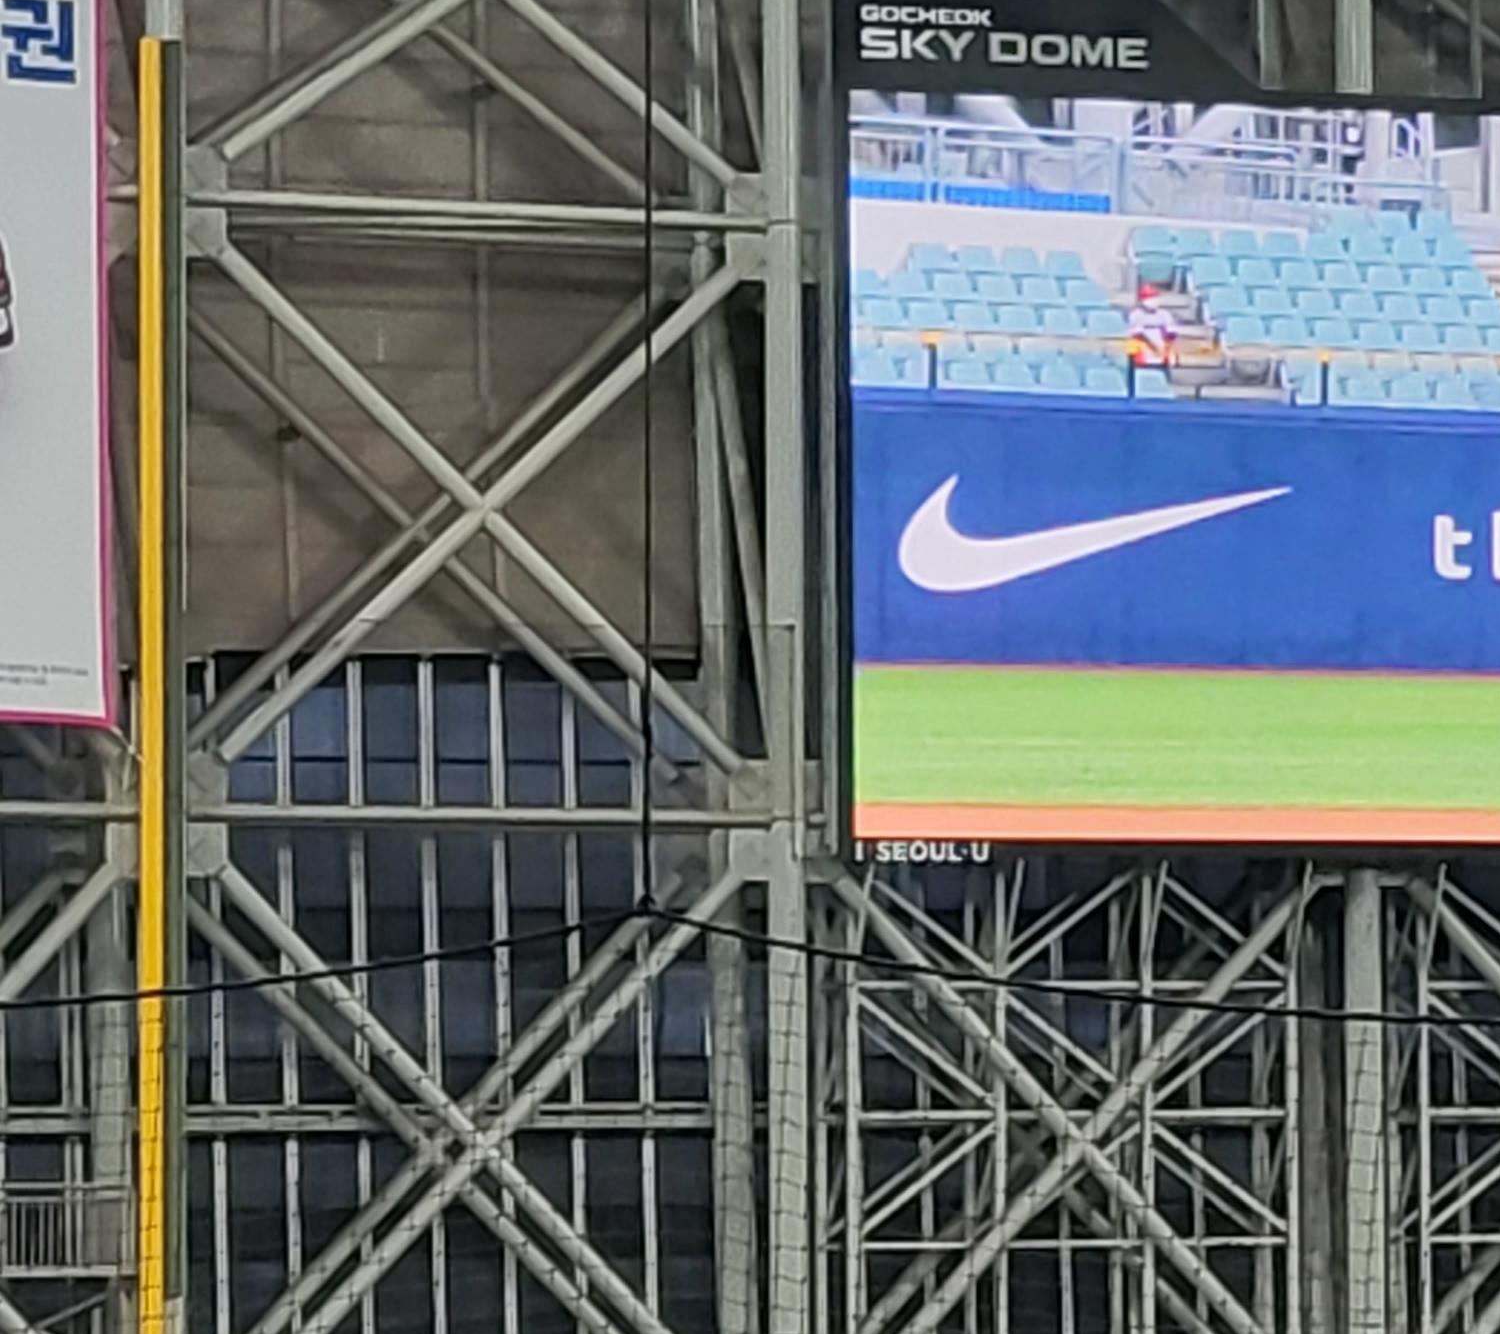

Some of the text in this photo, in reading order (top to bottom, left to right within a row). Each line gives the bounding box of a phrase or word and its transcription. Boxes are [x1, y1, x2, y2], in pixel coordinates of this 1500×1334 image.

[860, 4, 993, 27] GOCHEOK
[860, 27, 1150, 69] SKY DOME
